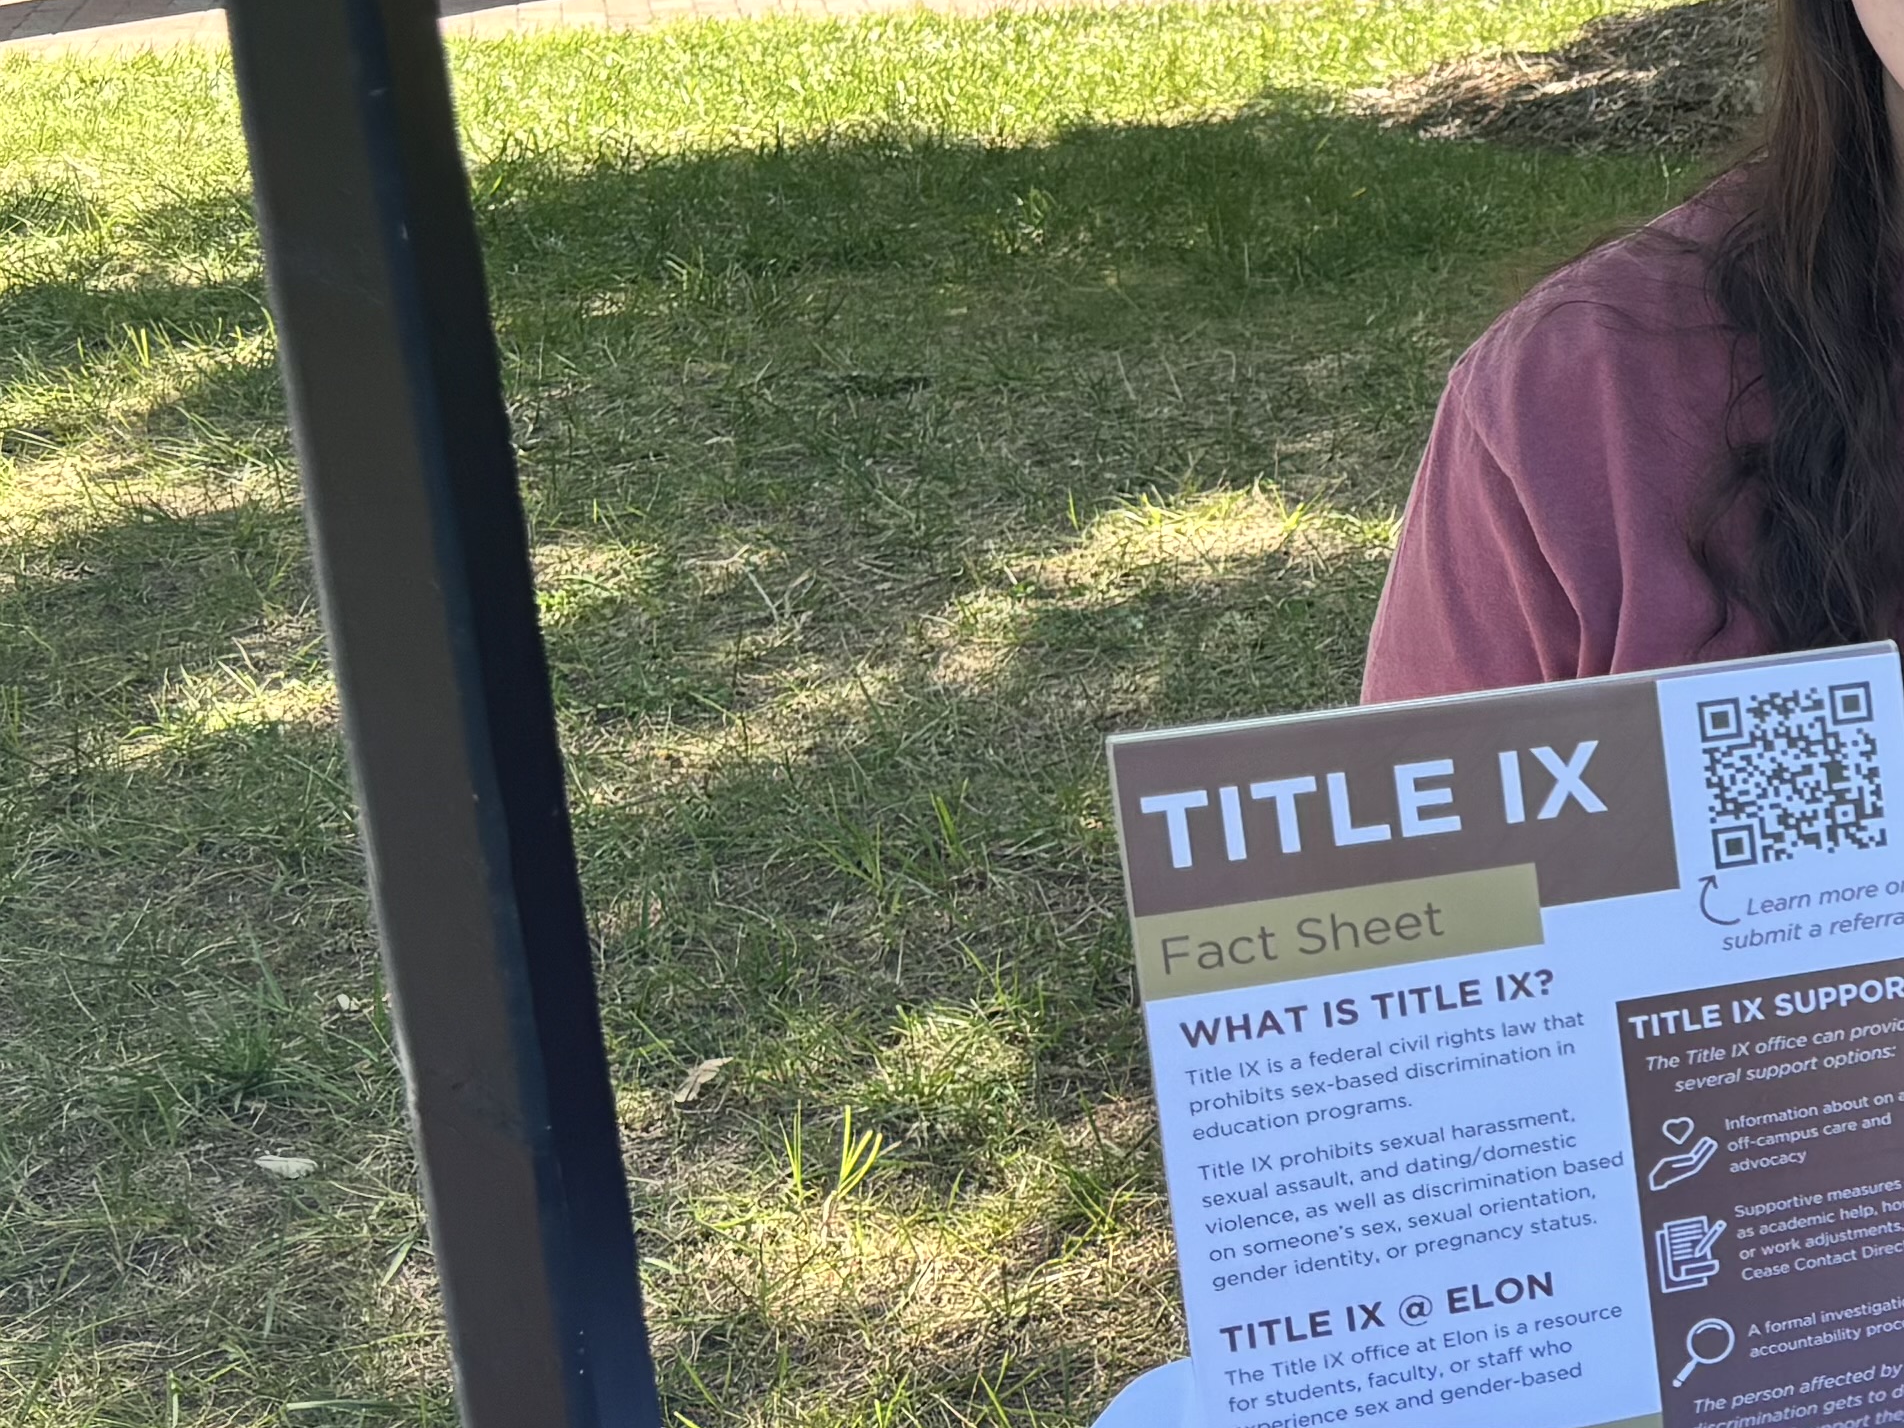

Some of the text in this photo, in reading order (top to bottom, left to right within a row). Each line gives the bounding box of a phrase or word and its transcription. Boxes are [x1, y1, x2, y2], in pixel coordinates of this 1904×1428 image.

[1139, 738, 1609, 868] TITLE IX
[1745, 892, 1812, 916] Learn
[1817, 882, 1879, 905] more
[1160, 901, 1445, 975] Fact Sheet
[1720, 922, 1803, 952] submit
[1807, 922, 1822, 939] a
[1178, 967, 1554, 1049] WHAT IS TITLE IX?
[1627, 1002, 1723, 1039] TITLE
[1731, 995, 1765, 1024] IX
[1183, 1011, 1585, 1086] Title IX is a federal civil rights law that
[1644, 1054, 1681, 1071] The
[1685, 1045, 1726, 1065] Title
[1730, 1040, 1750, 1058] IX
[1753, 1034, 1808, 1055] office
[1811, 1028, 1845, 1045] can
[1673, 1045, 1897, 1093] several support options:
[1188, 1040, 1575, 1117] prohibits sex-based discrimination in
[1191, 1095, 1412, 1141] education programs.
[1218, 1270, 1554, 1353] TITLE IX @ ELON
[1746, 1322, 1762, 1337] A
[1763, 1311, 1817, 1334] formal
[1748, 1326, 1862, 1358] accountability
